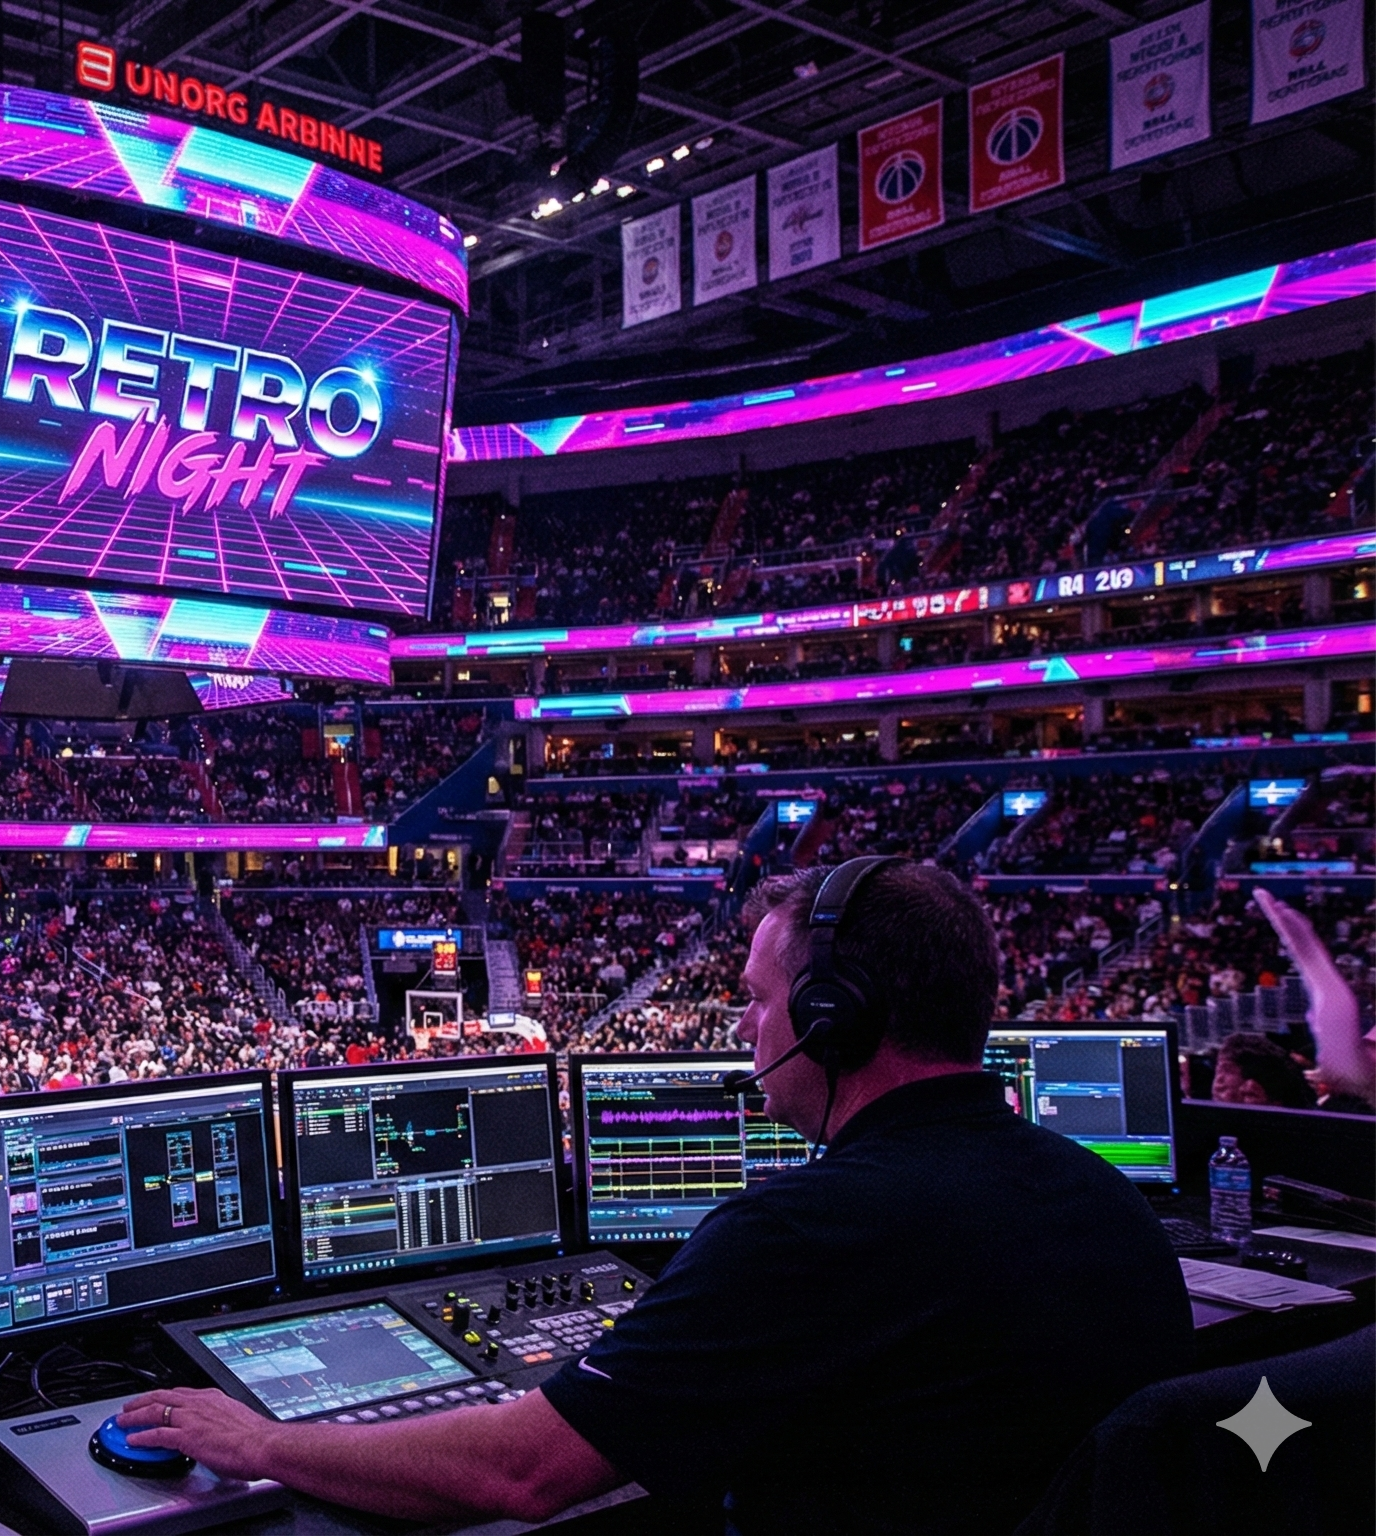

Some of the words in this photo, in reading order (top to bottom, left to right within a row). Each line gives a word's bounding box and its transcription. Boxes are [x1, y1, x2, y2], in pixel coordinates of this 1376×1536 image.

[125, 60, 249, 125] UNORG
[256, 101, 384, 174] ARBINNE
[2, 303, 384, 459] RETRO
[58, 408, 331, 520] NIGHT
